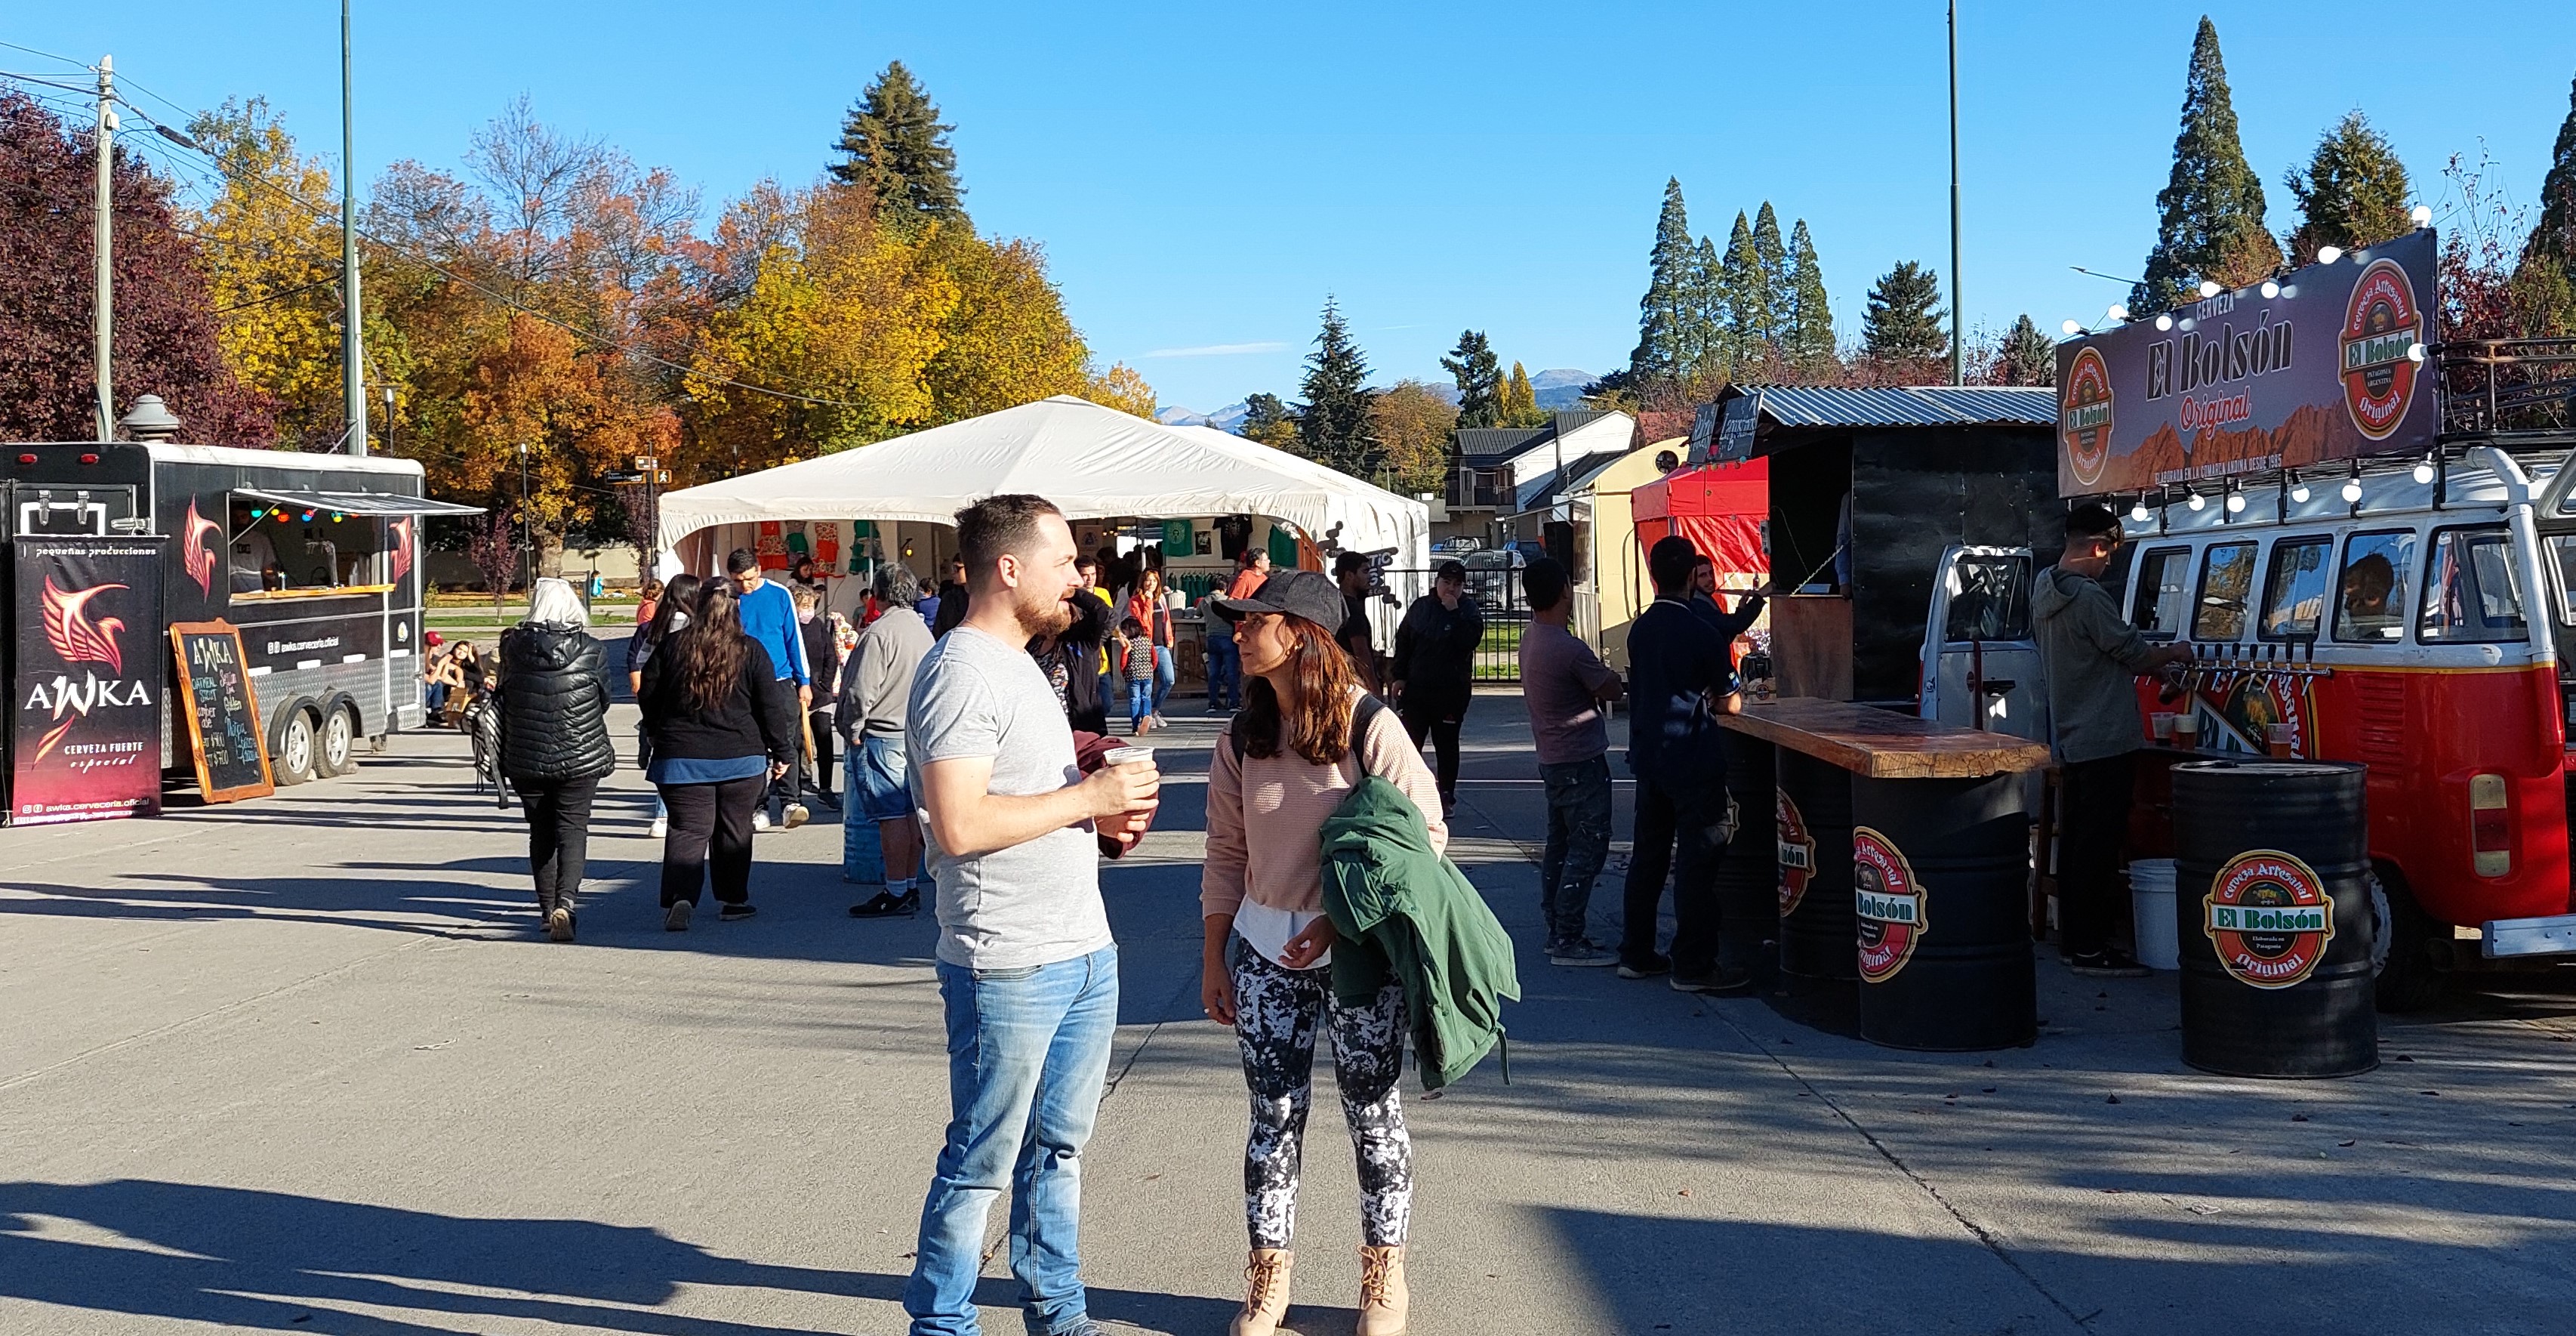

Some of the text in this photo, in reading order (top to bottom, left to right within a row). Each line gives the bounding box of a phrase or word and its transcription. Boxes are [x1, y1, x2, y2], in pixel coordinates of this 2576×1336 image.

[2196, 293, 2235, 322] CERVEZA
[2146, 308, 2294, 402] El Bolsón
[2348, 341, 2361, 368] El
[2069, 403, 2107, 429] El Bolsón
[2180, 385, 2252, 440] Original
[2359, 390, 2402, 423] Original
[36, 546, 156, 558] pequeñas producciones
[193, 637, 234, 673] AWKA
[24, 669, 153, 721] AWKA
[64, 742, 144, 755] CERVEZA FUERTE
[70, 754, 137, 774] especial
[2256, 863, 2313, 899] Artesanal
[1857, 891, 1912, 921] Bolsón
[2217, 908, 2322, 930] El Bolsón
[1860, 945, 1893, 967] riginal
[2236, 953, 2304, 977] Original
